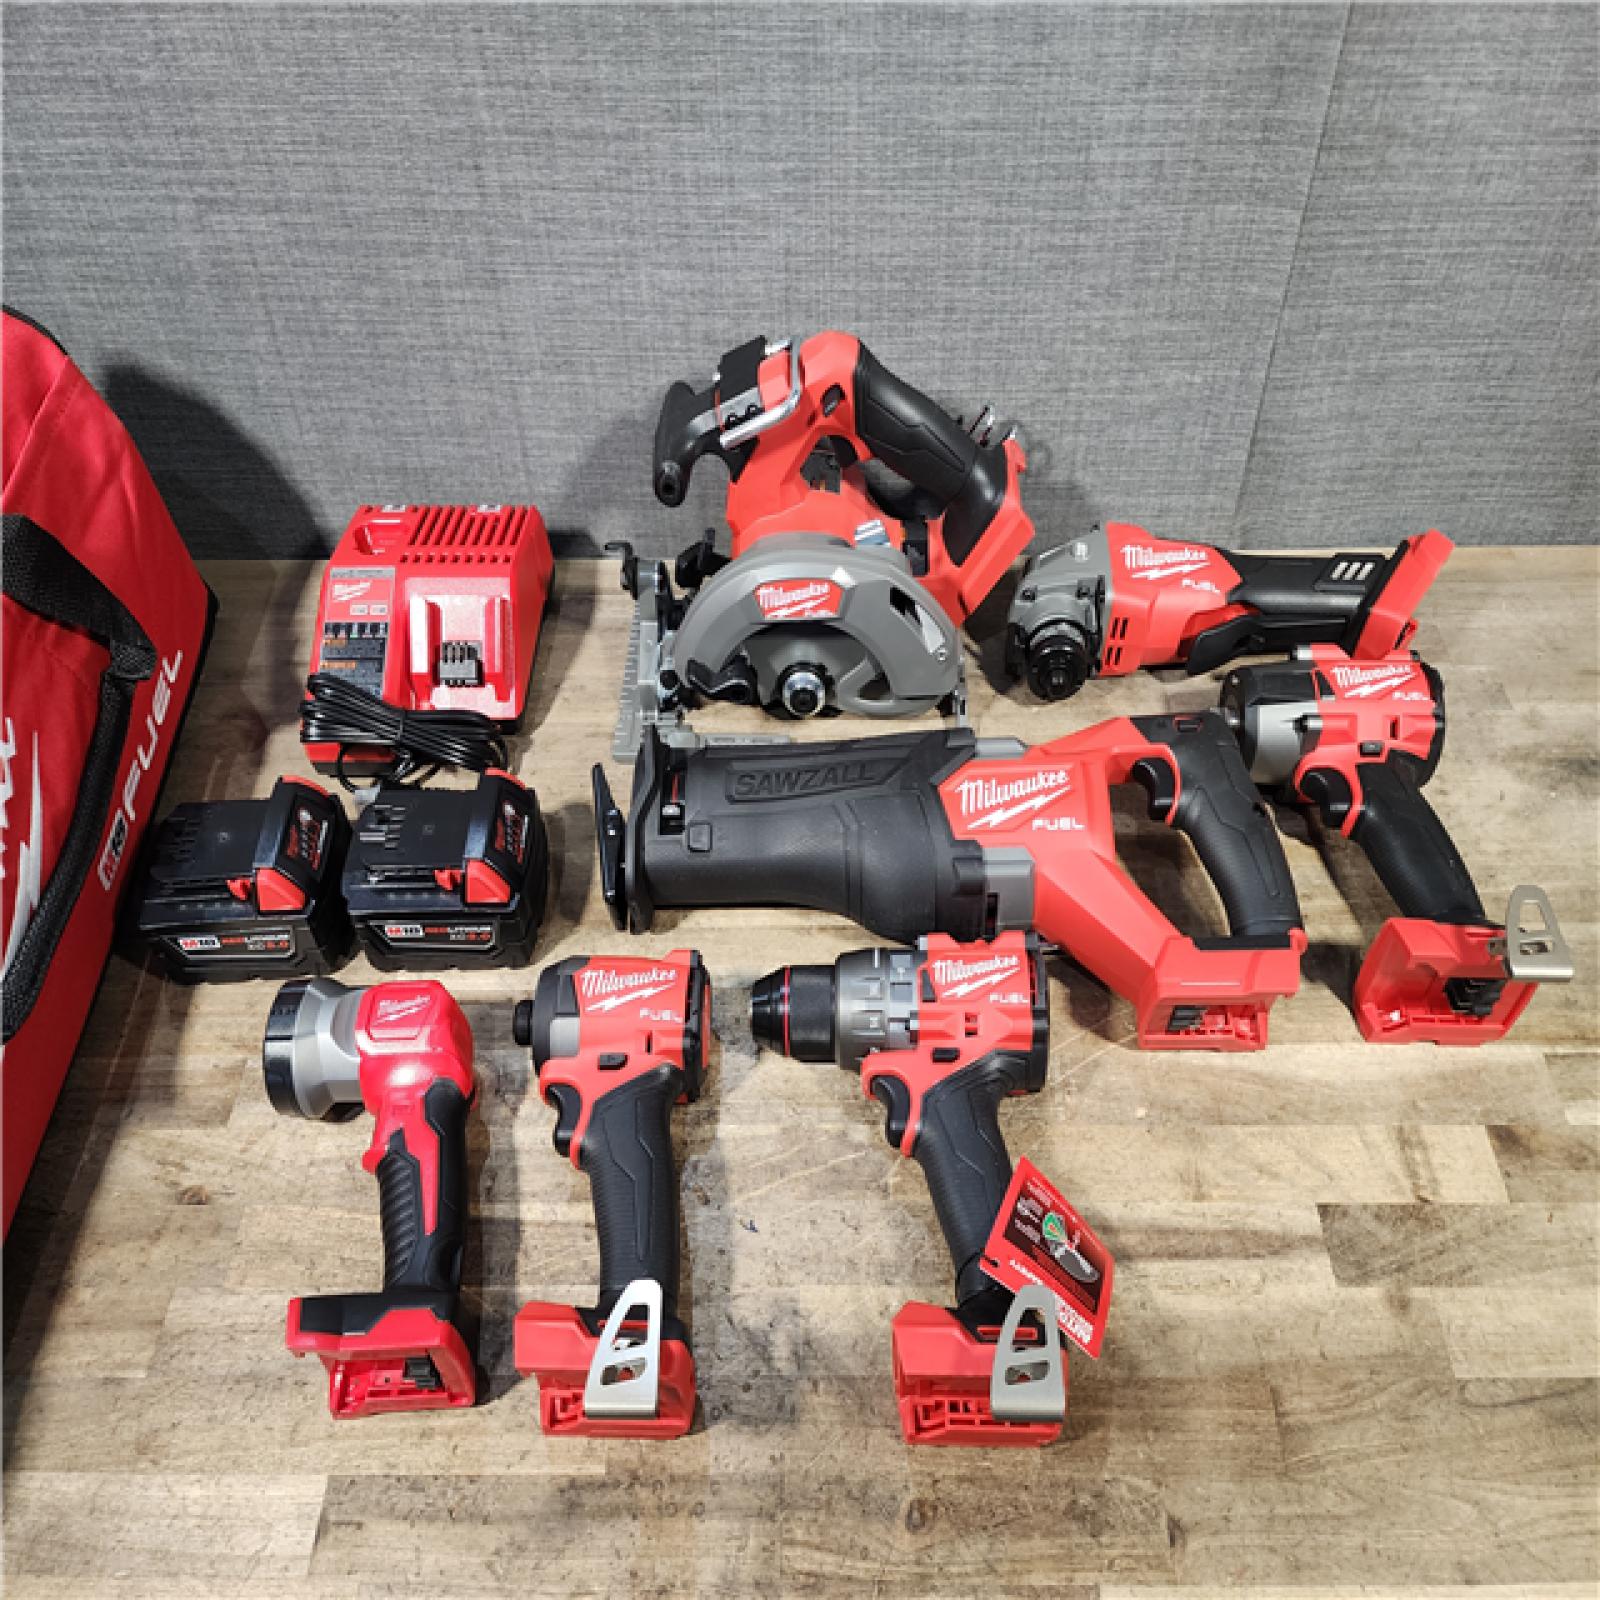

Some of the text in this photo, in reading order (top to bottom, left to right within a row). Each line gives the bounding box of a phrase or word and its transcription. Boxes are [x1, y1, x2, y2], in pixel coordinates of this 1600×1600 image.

[1119, 544, 1208, 571] Milwaukee
[1181, 578, 1221, 594] FUEL
[1330, 664, 1412, 688] Milwaukee
[123, 649, 183, 822] FUEL
[734, 763, 877, 797] SAWZALL
[955, 768, 1069, 815] Milwaukee
[1032, 817, 1085, 831] FUEL
[582, 967, 677, 998] Milwaukee
[932, 954, 1019, 985] Milwaukee
[989, 992, 1029, 1004] FUEL
[639, 1008, 684, 1024] FUEL
